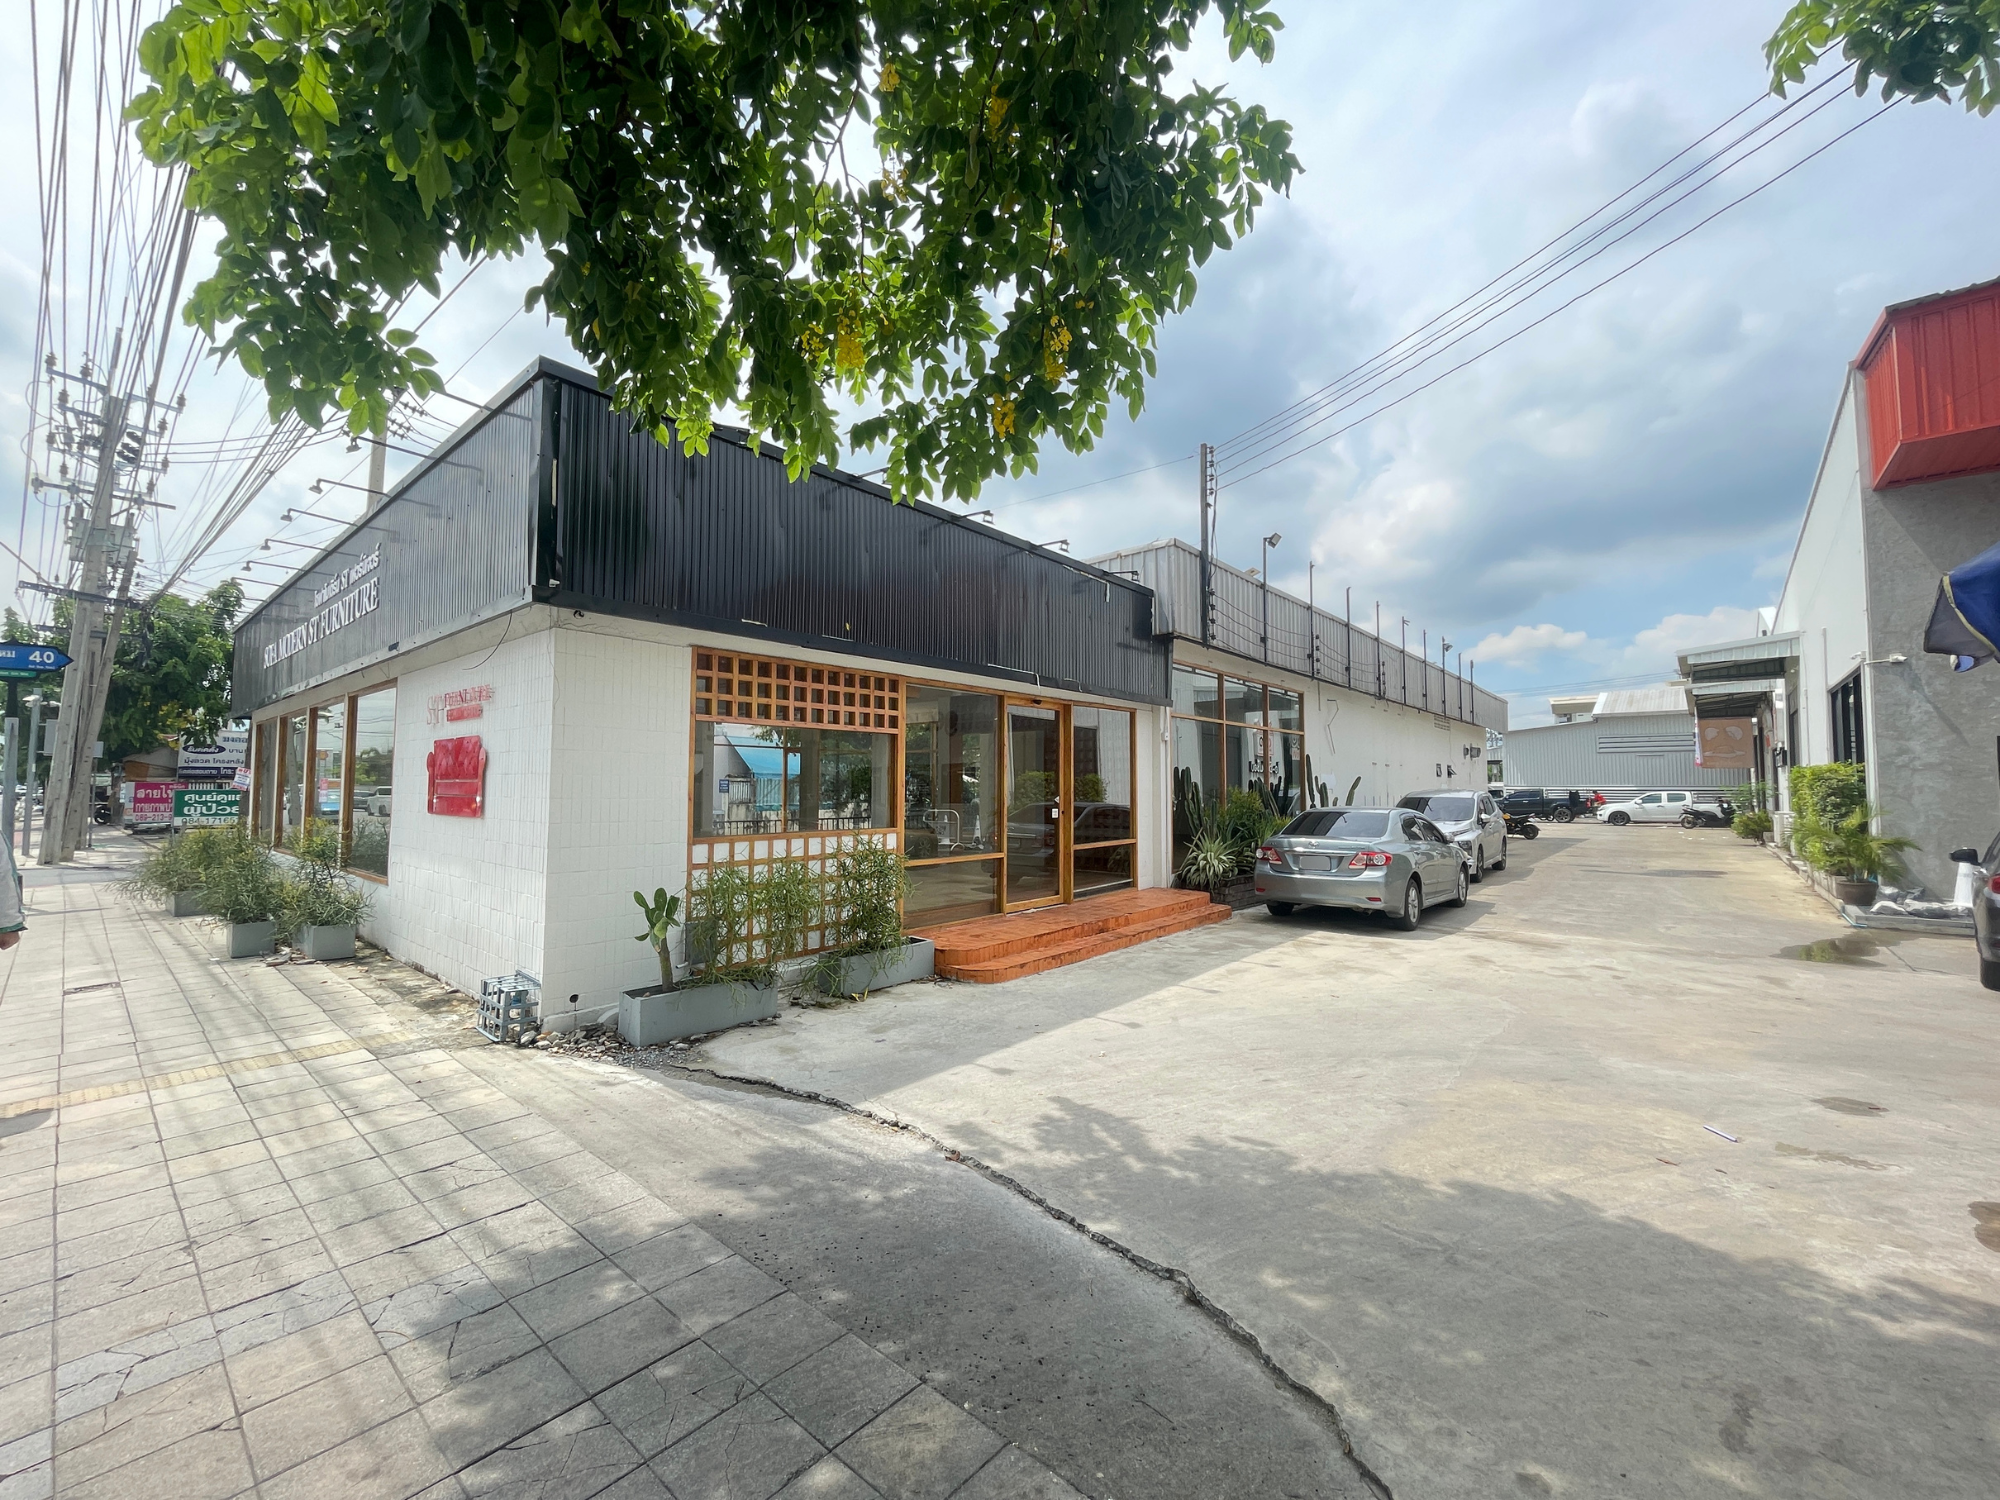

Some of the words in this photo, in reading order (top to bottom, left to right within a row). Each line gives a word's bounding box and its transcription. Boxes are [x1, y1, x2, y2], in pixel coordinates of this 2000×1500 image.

[278, 622, 307, 661] MODERN
[308, 617, 319, 645] ST
[320, 577, 380, 639] FURNITURE
[28, 651, 55, 664] 40
